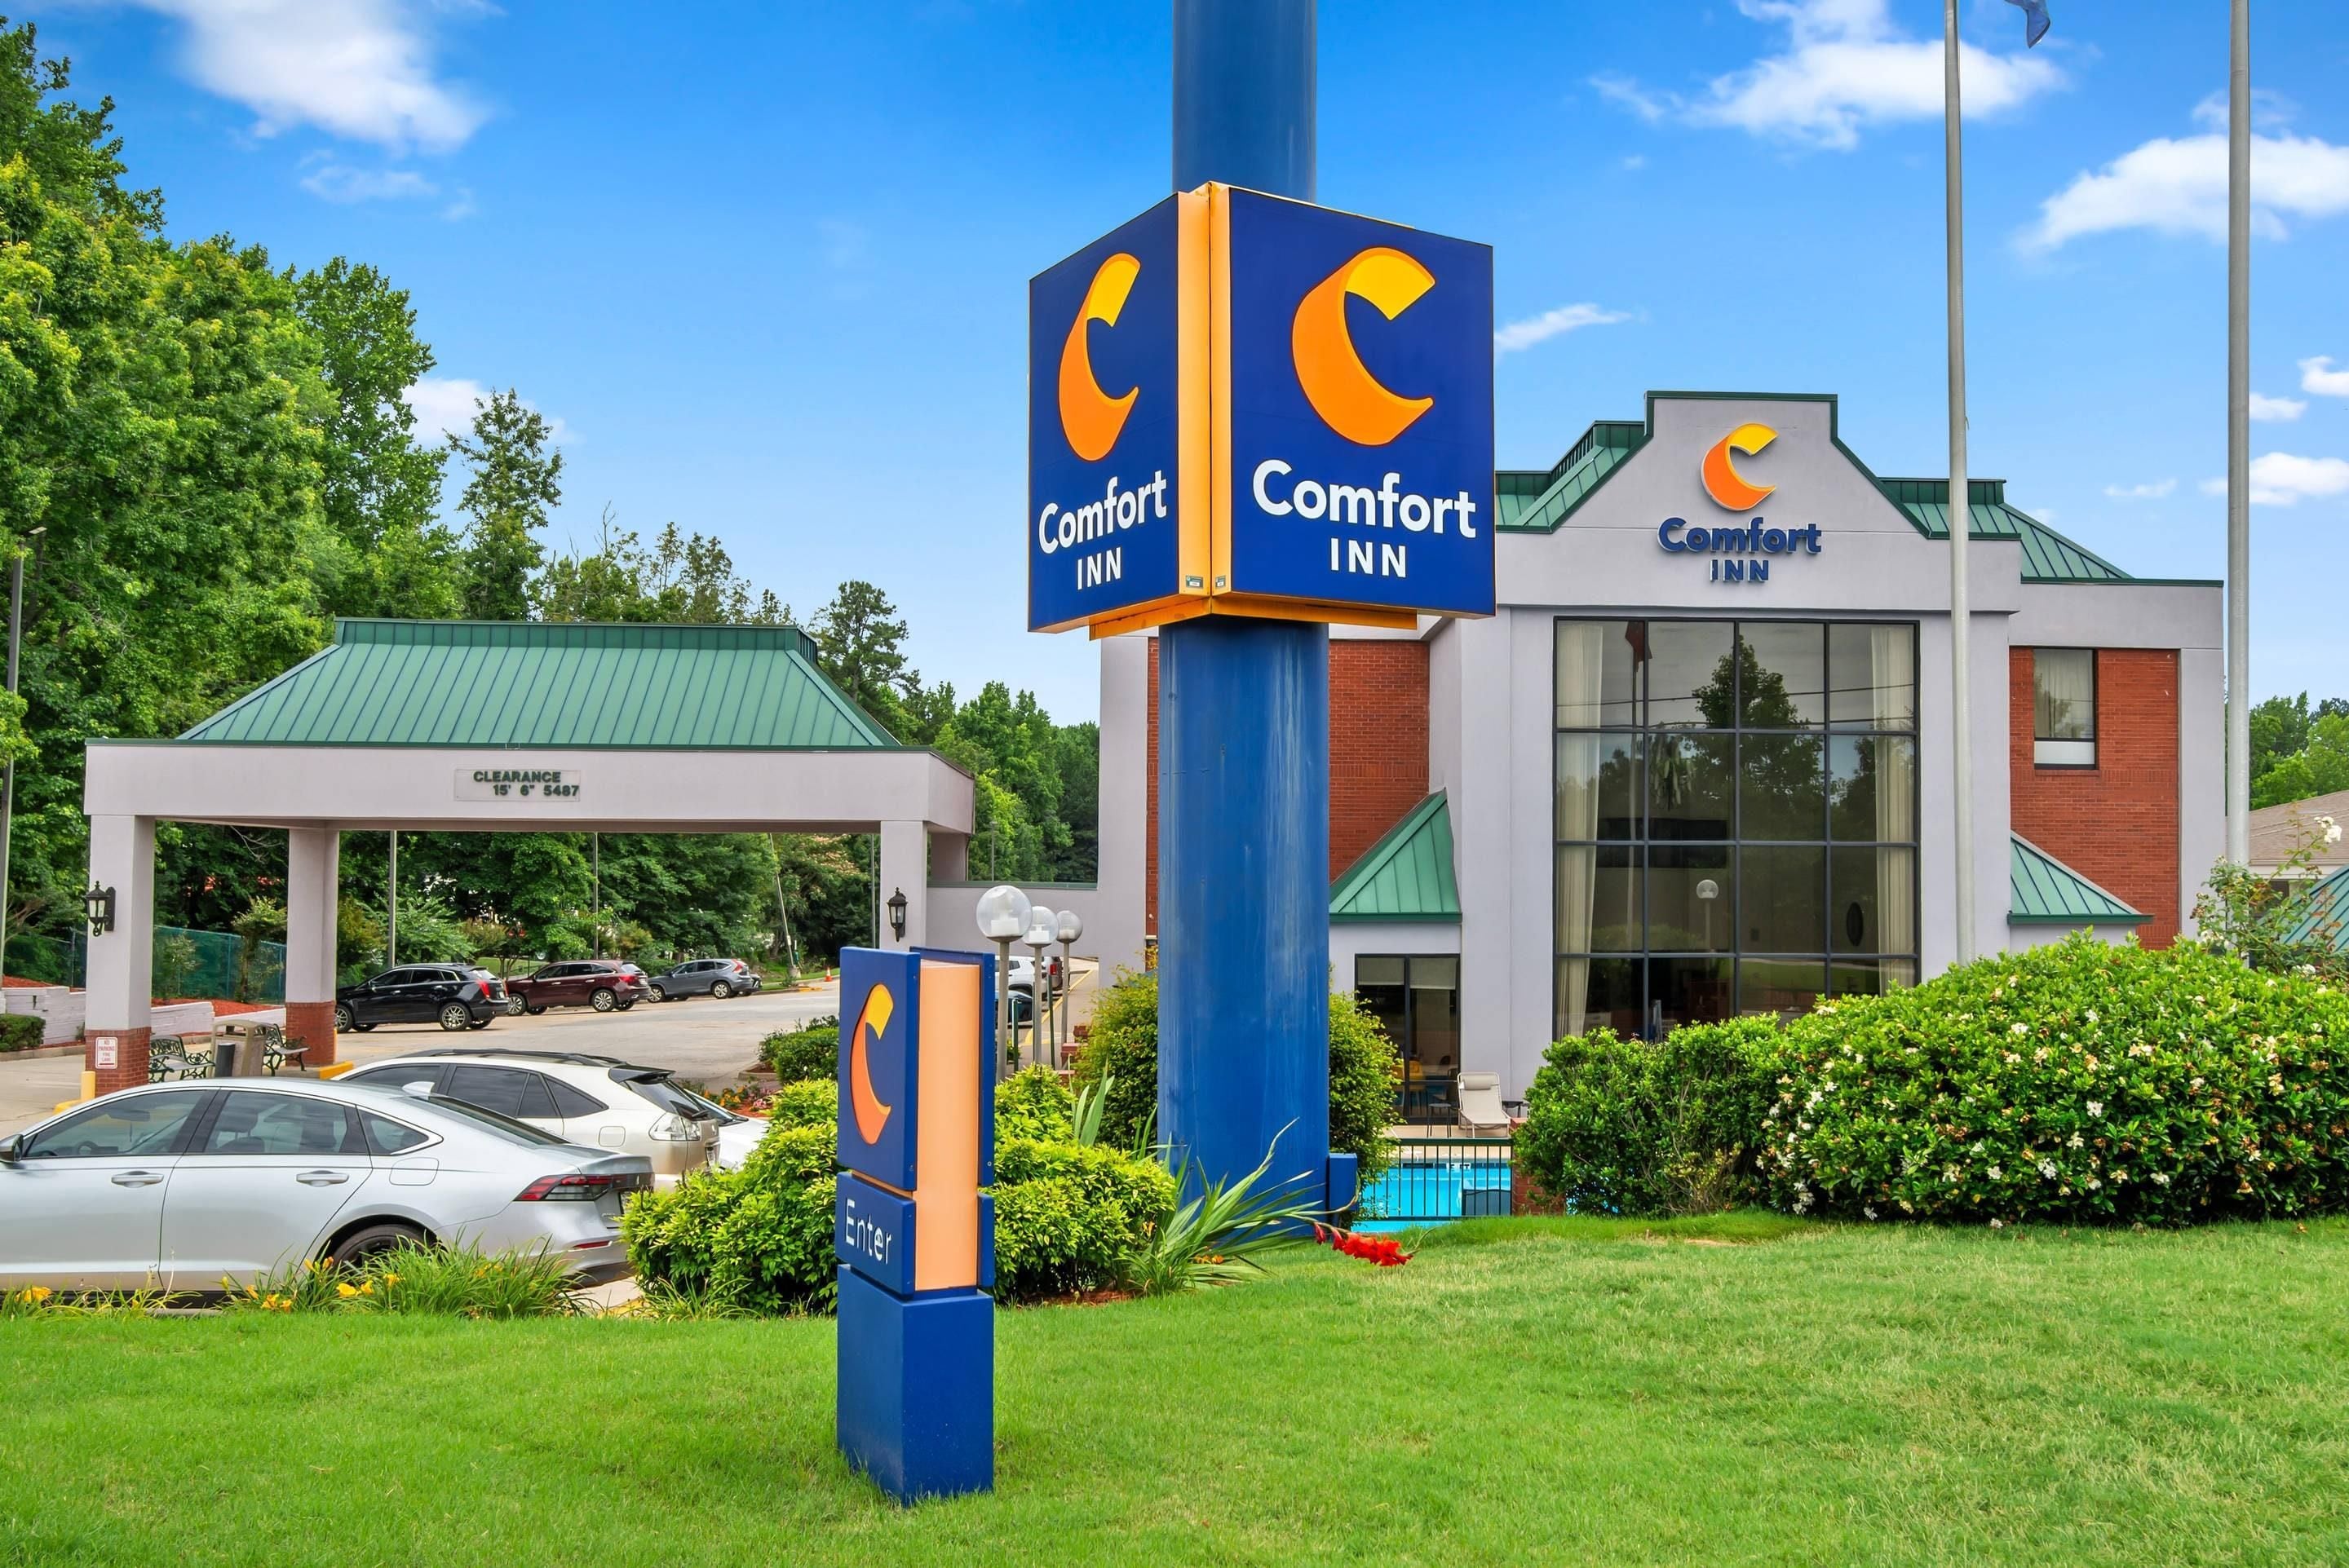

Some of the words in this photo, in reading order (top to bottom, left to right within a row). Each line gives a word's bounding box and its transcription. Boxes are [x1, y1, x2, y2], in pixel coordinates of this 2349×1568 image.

[1039, 470, 1166, 554] Comfort
[1253, 459, 1476, 538] Comfort
[1657, 517, 1822, 553] Comfort
[1077, 546, 1121, 590] INN
[1330, 537, 1406, 578] INN
[1710, 559, 1769, 581] INN
[473, 771, 561, 783] CLEARANCE
[543, 785, 579, 796] 5487
[846, 1199, 891, 1265] Enter
